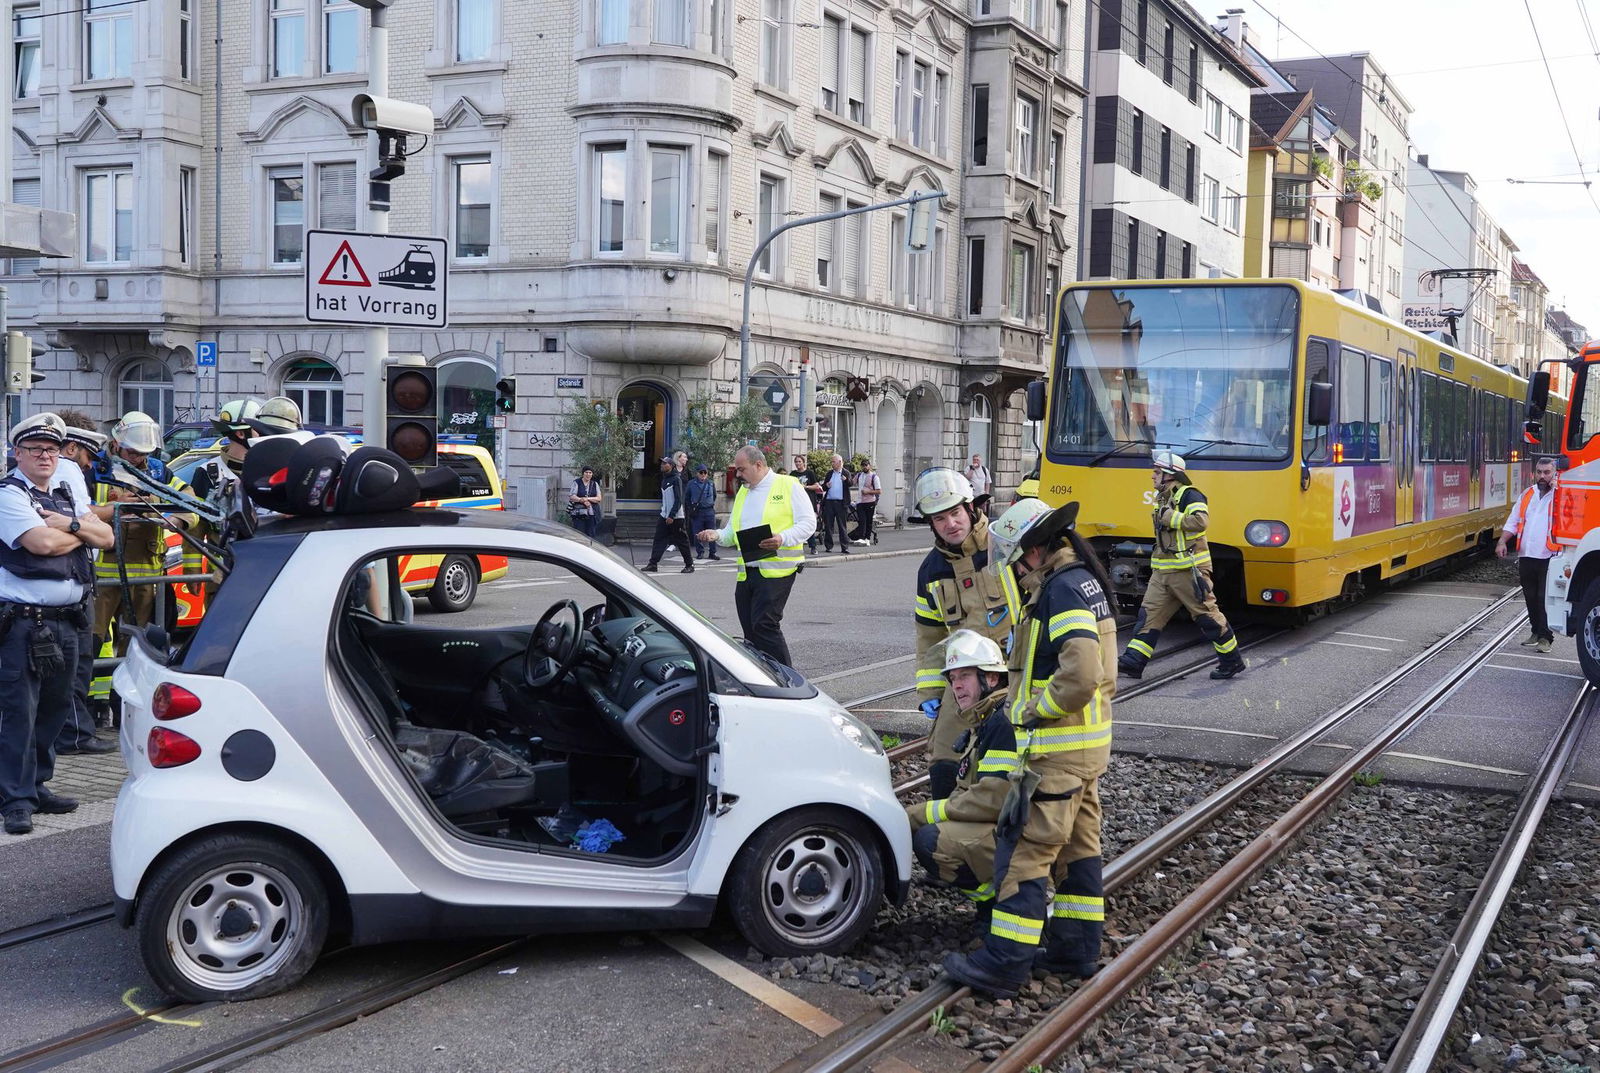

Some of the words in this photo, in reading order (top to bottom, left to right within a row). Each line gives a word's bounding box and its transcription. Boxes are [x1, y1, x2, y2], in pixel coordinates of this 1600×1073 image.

[316, 293, 347, 311] hat
[358, 295, 437, 320] Vorrang
[200, 345, 211, 363] P
[1050, 486, 1072, 494] 4094
